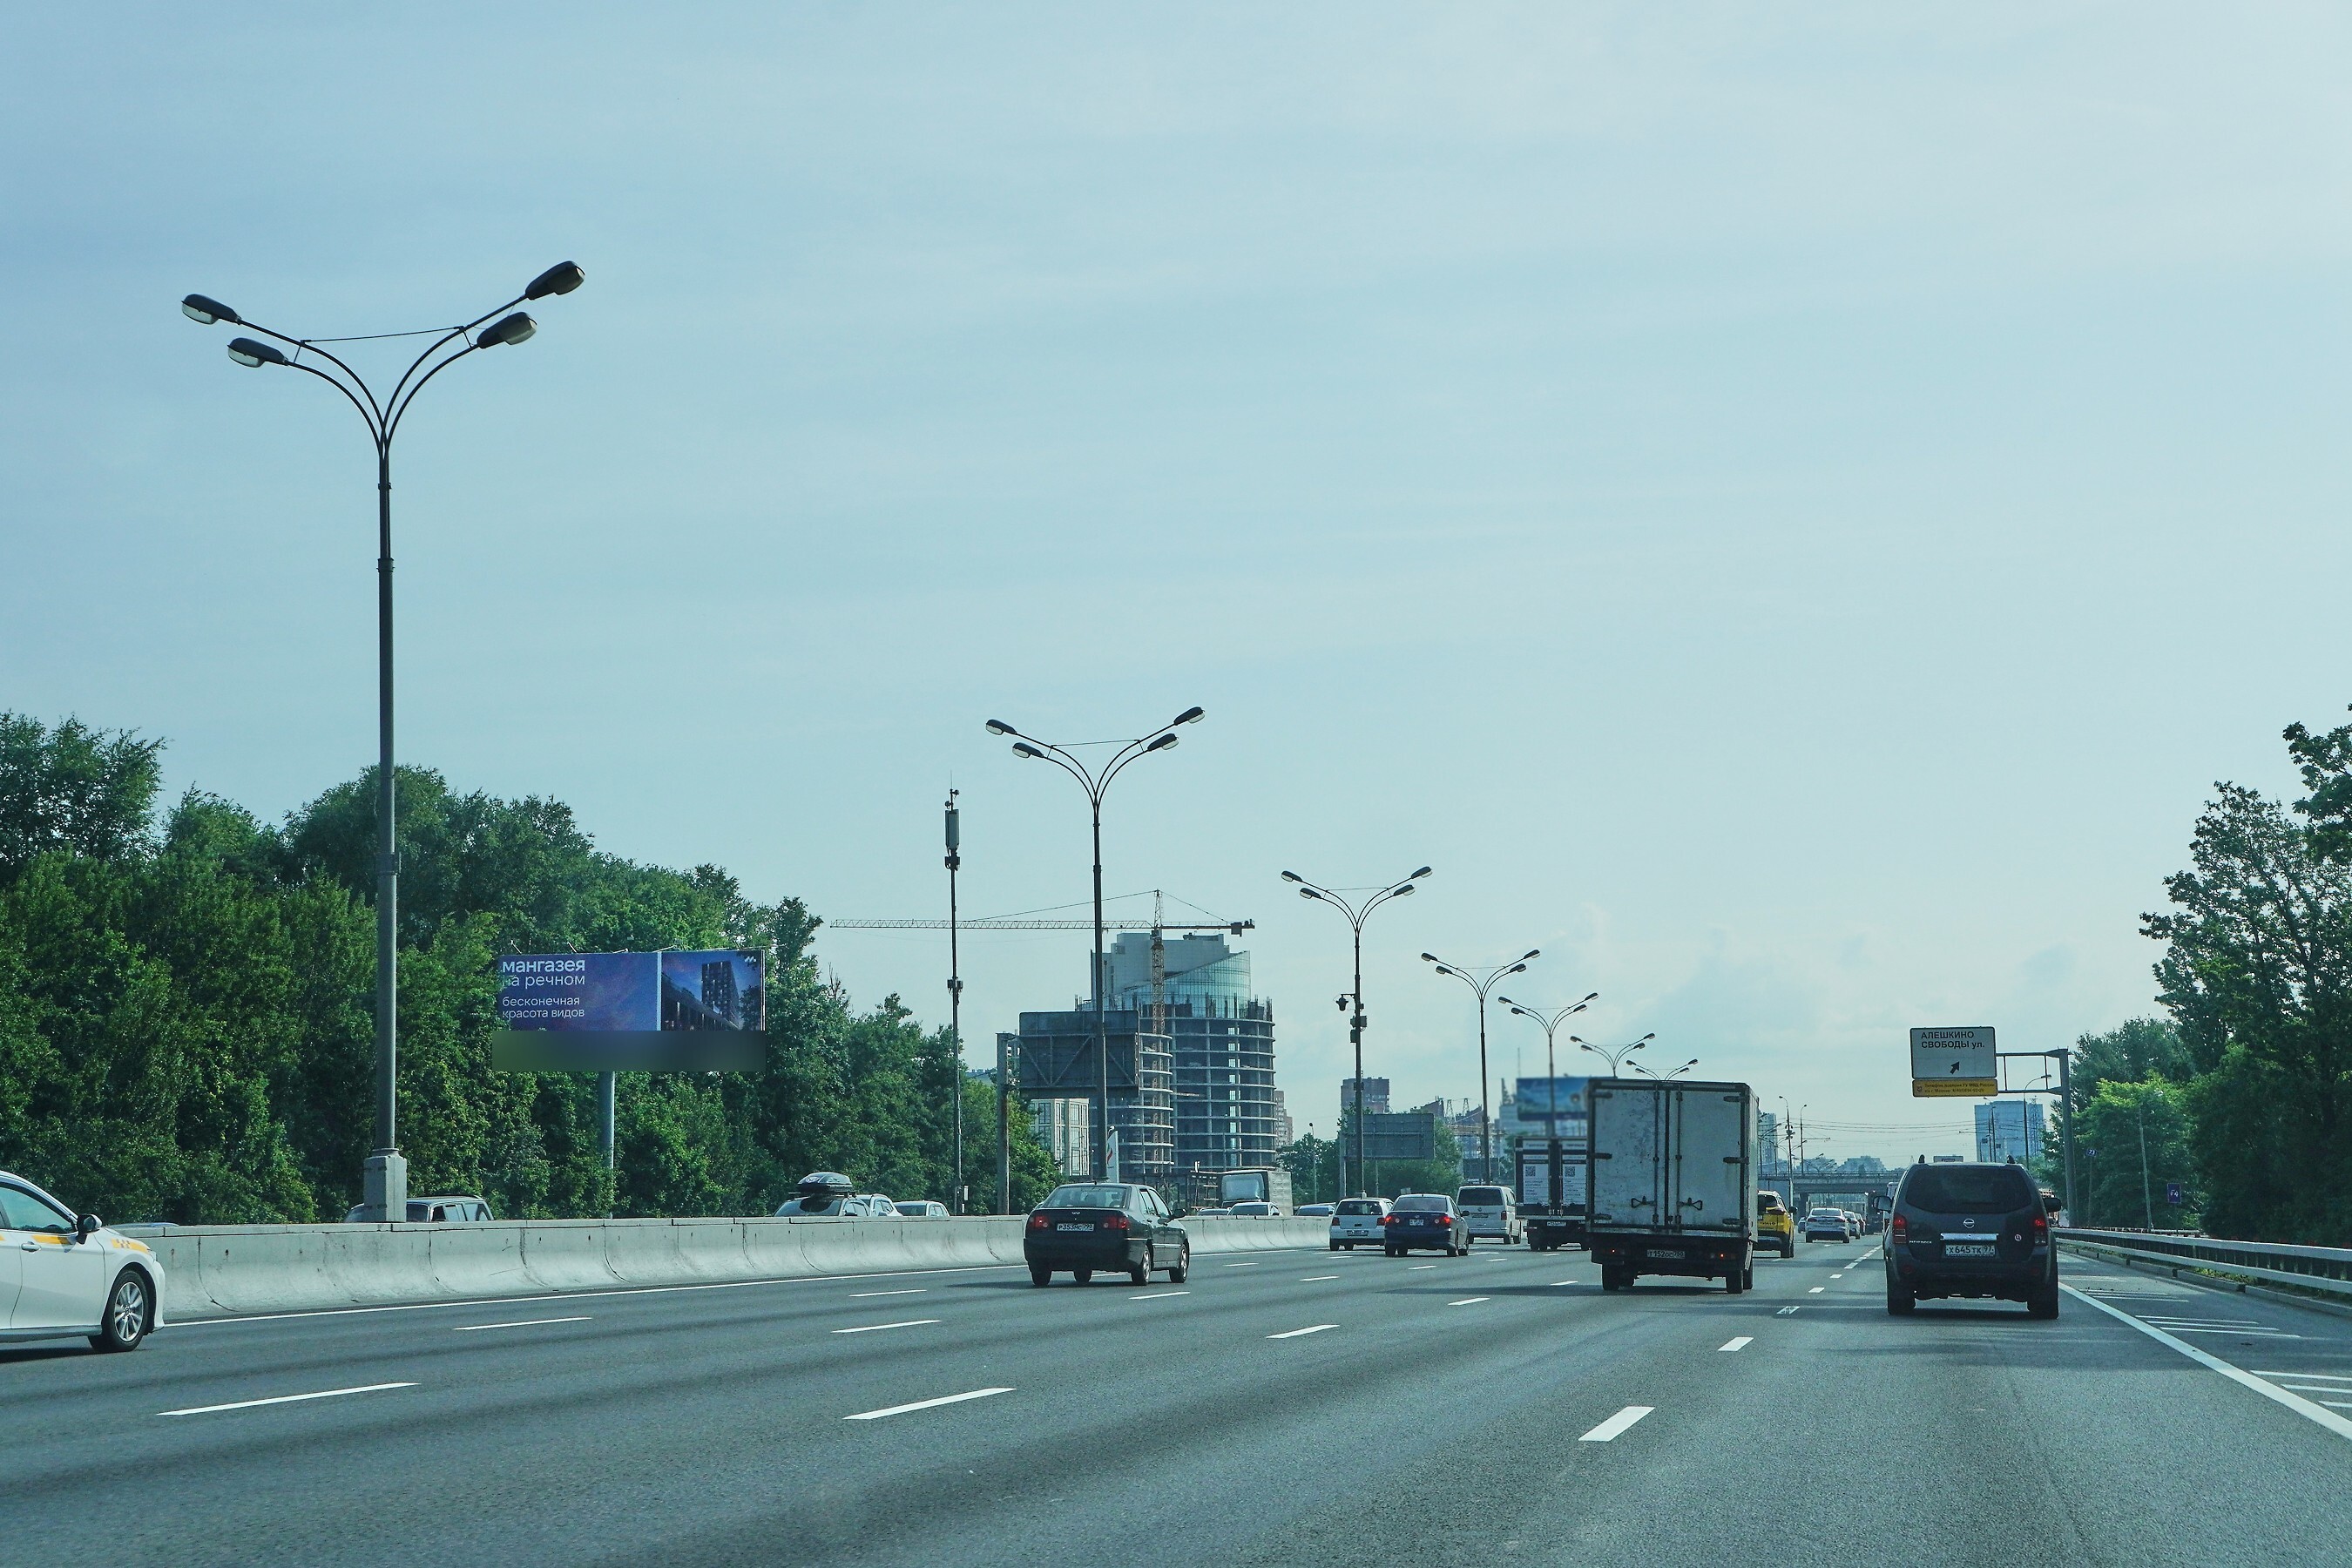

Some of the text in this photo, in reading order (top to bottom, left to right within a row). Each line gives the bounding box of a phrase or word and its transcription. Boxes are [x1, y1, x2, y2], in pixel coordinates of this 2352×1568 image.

[502, 959, 585, 973] мангазея
[524, 975, 585, 990] речном
[502, 996, 580, 1007] бесконечная
[502, 1009, 585, 1019] красота видов
[1921, 1031, 1975, 1039] АЛЕШКИНО
[1921, 1040, 1970, 1049] СВОБОДЫ
